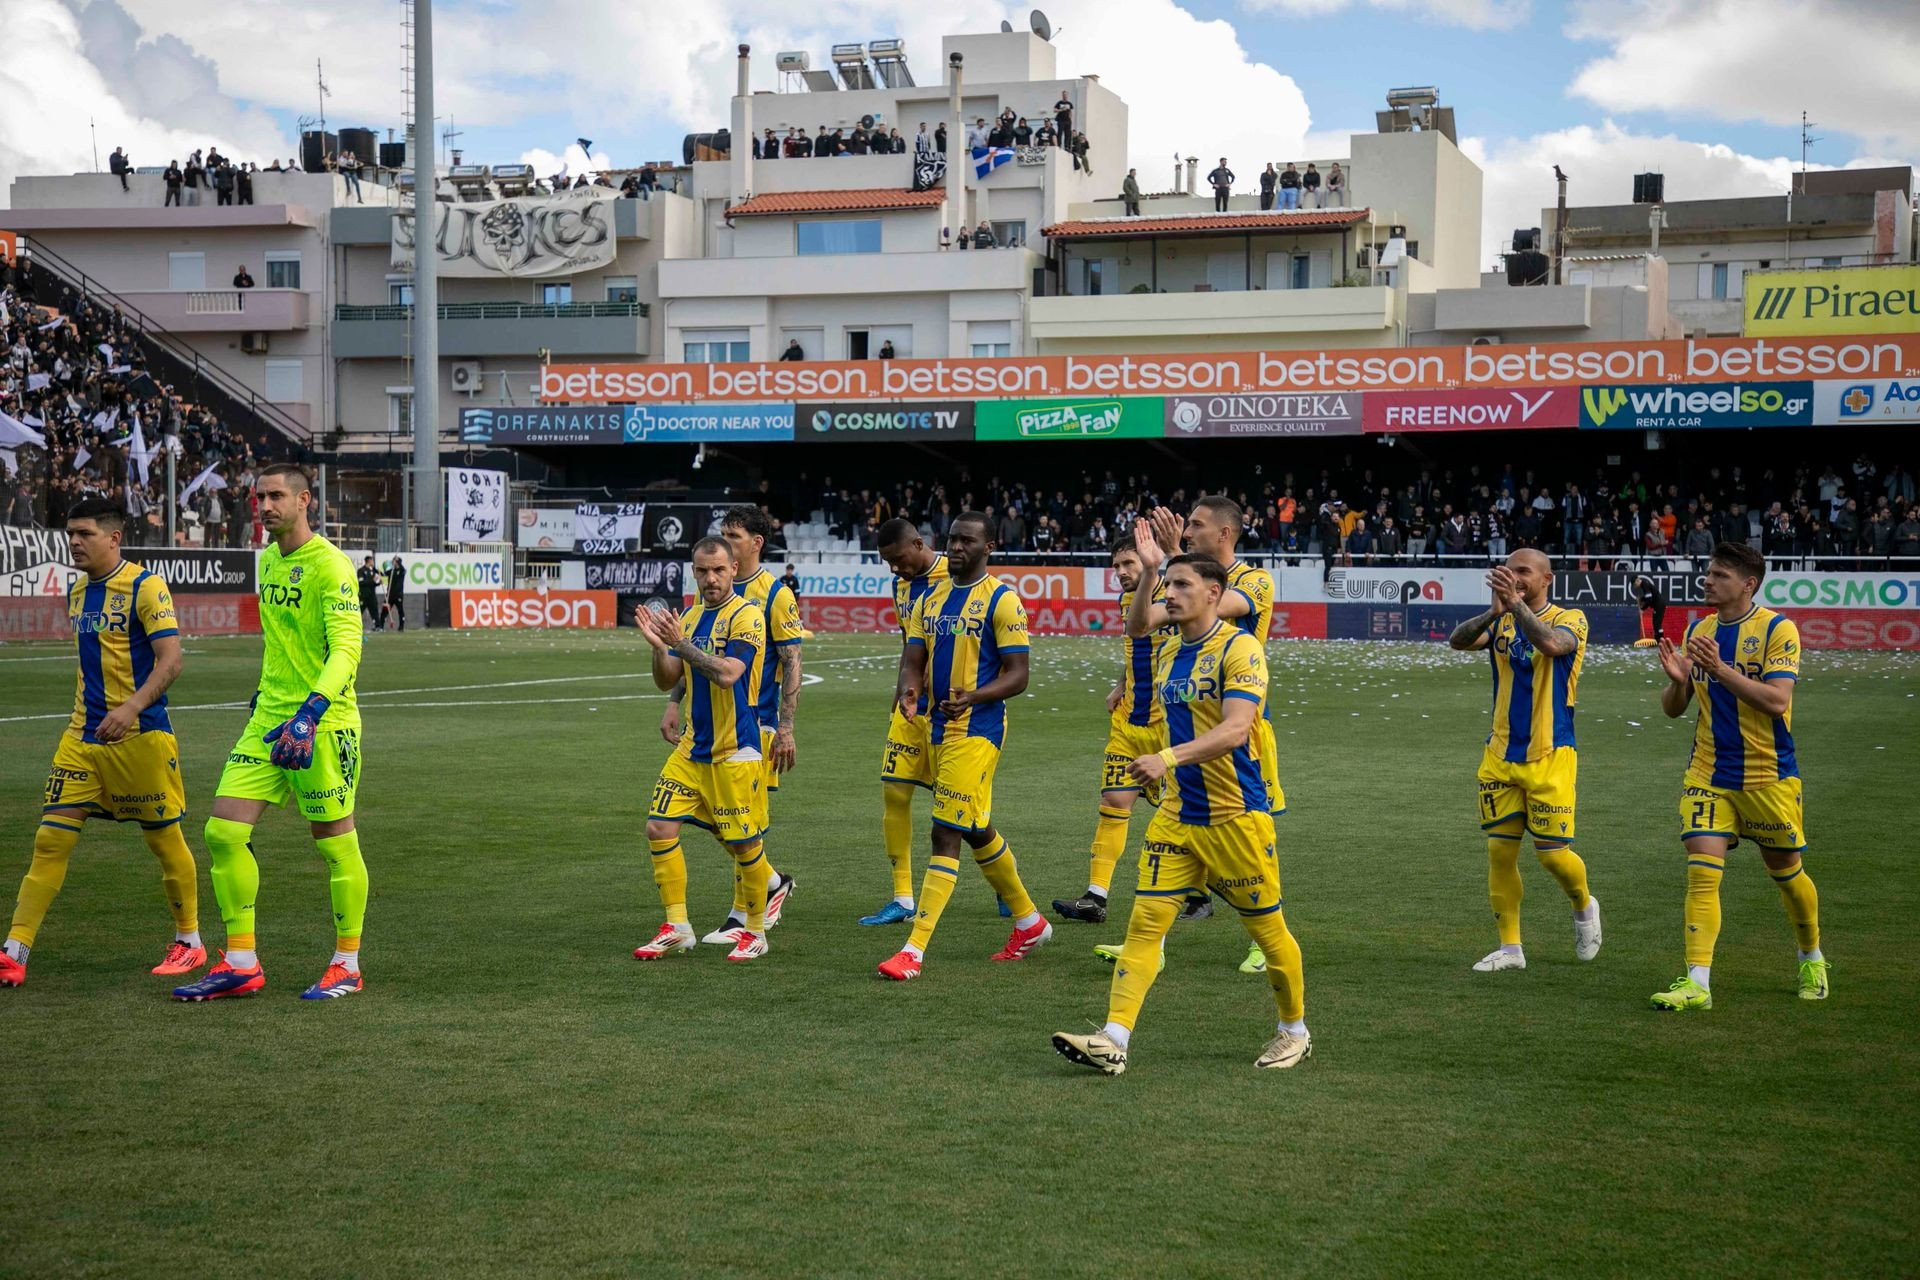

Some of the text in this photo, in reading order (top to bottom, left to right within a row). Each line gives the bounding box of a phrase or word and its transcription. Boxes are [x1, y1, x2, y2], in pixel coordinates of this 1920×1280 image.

[1259, 351, 1444, 387] betsson
[1465, 345, 1682, 382] betsson 21+
[1686, 339, 1903, 377] betsson
[541, 365, 693, 397] betsson
[708, 363, 867, 396] betsson
[882, 359, 1047, 393] betsson
[1066, 355, 1241, 390] betsson
[1207, 395, 1350, 418] OINOTEKA
[1630, 386, 1809, 415] wheelso.gr
[497, 413, 621, 432] ORFANAKIS
[657, 413, 794, 431] DOCTOR NEAR YOU
[834, 411, 959, 430] COSMOTE TV
[1229, 421, 1327, 432] EXPERIENCE QUALITY
[1636, 417, 1701, 427] RENT A CAR
[526, 434, 590, 442] CONSTRUCTION
[146, 559, 246, 584] VAVOULAS GROUP
[409, 561, 500, 585] COSMOTE
[603, 561, 663, 585] ATHENS CLUB
[1606, 574, 1707, 602] HOTELS
[460, 591, 597, 627] betsson
[1105, 764, 1126, 787] 22
[1691, 801, 1715, 829] 21
[1148, 855, 1161, 887] 7
